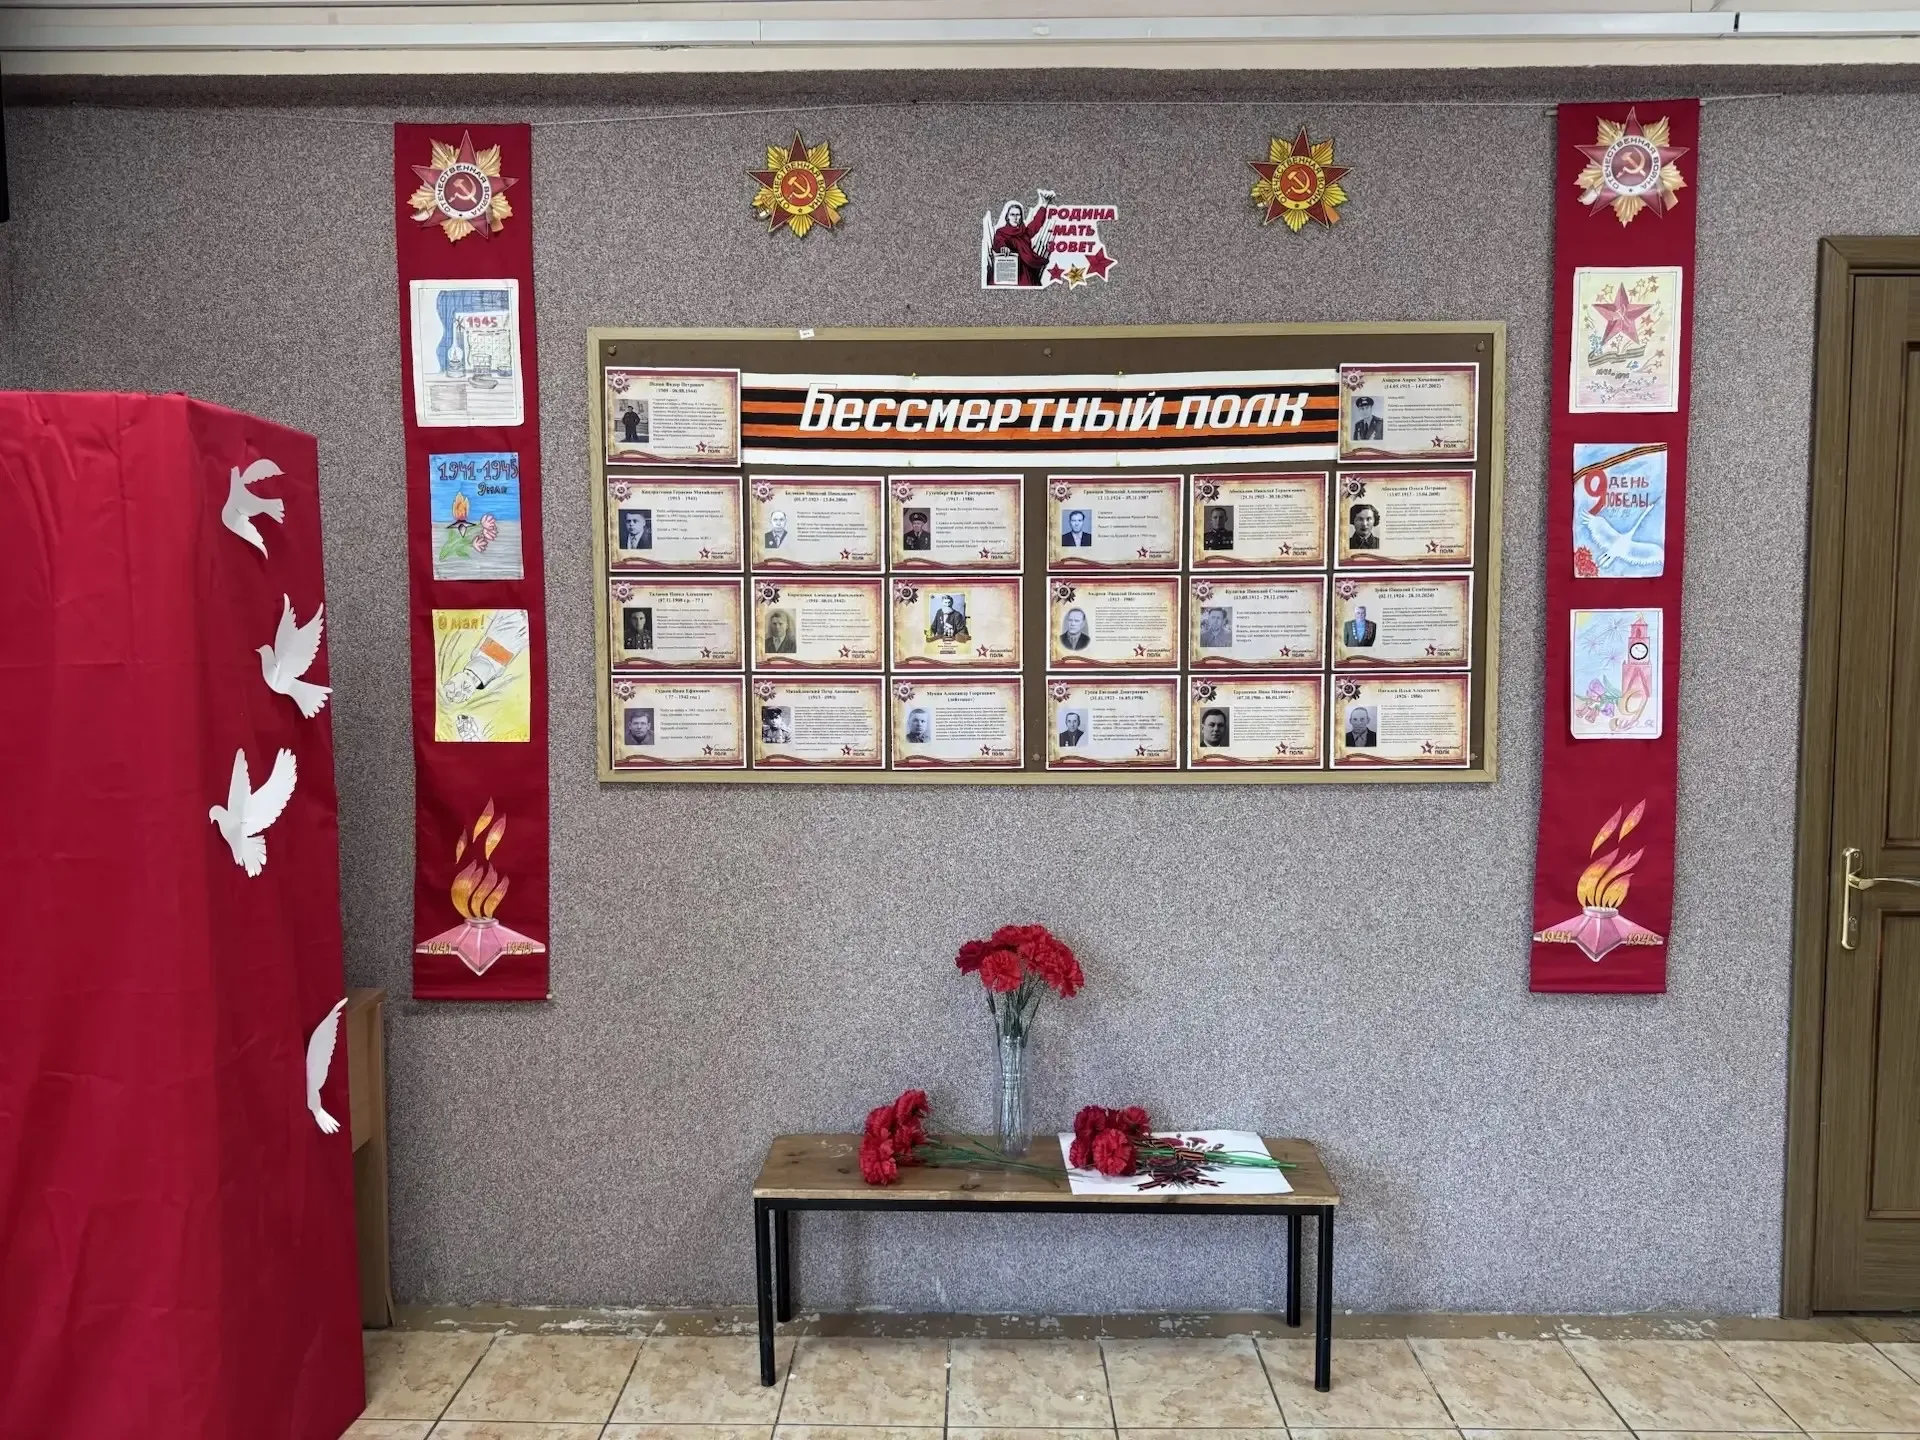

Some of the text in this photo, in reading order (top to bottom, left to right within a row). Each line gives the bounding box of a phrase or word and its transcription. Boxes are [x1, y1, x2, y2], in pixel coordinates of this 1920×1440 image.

[1604, 137, 1656, 189] ОТЕЧЕСТВЕННАЯ
[437, 165, 487, 213] ОТЕЧЕСТВЕННАЯ
[1047, 208, 1115, 221] РОДИНА
[1046, 241, 1096, 253] ЗОВЕТ
[466, 316, 498, 329] 1945
[1584, 468, 1649, 516] 9 ДЕНЬ
[1604, 492, 1649, 508] ПОБЕДЫ
[1541, 931, 1658, 945] 1941 1945
